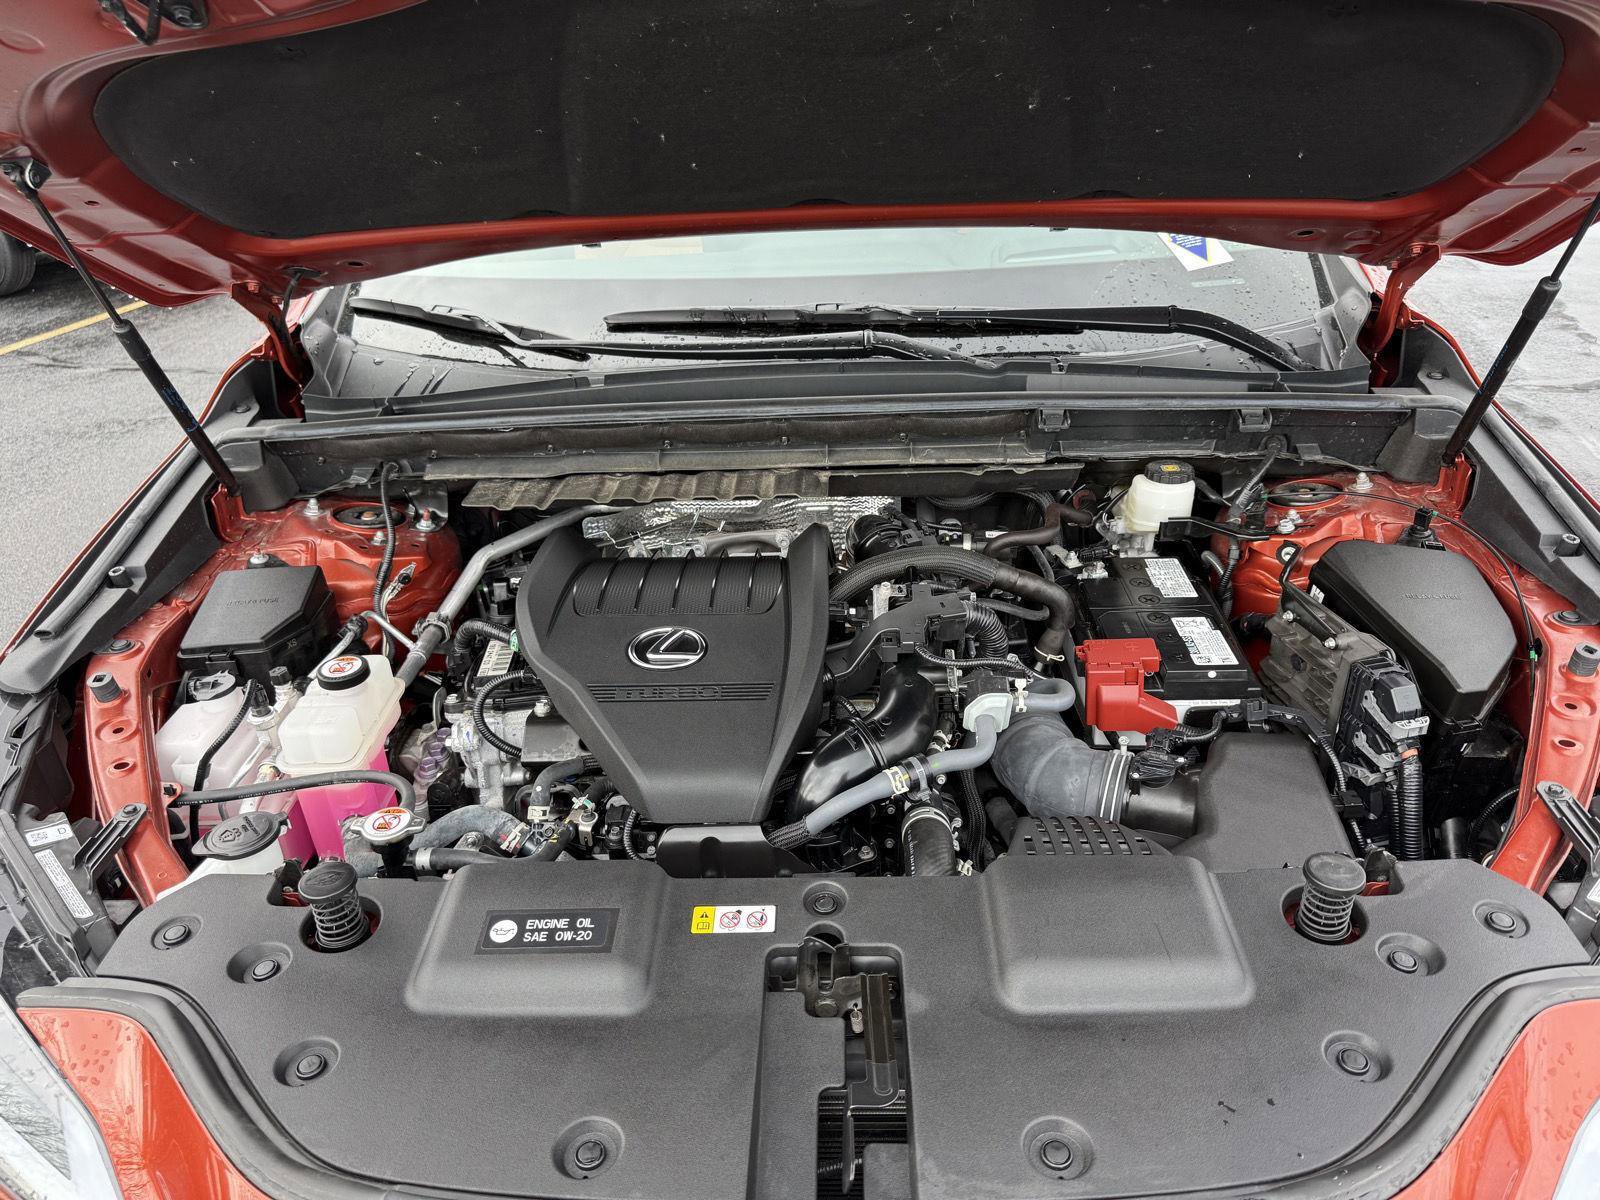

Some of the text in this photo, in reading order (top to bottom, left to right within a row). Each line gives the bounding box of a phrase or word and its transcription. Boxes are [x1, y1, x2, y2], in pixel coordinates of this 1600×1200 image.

[617, 686, 719, 699] TURBO
[526, 918, 595, 929] ENGINE OIL
[523, 930, 593, 942] SAE 0W-20
